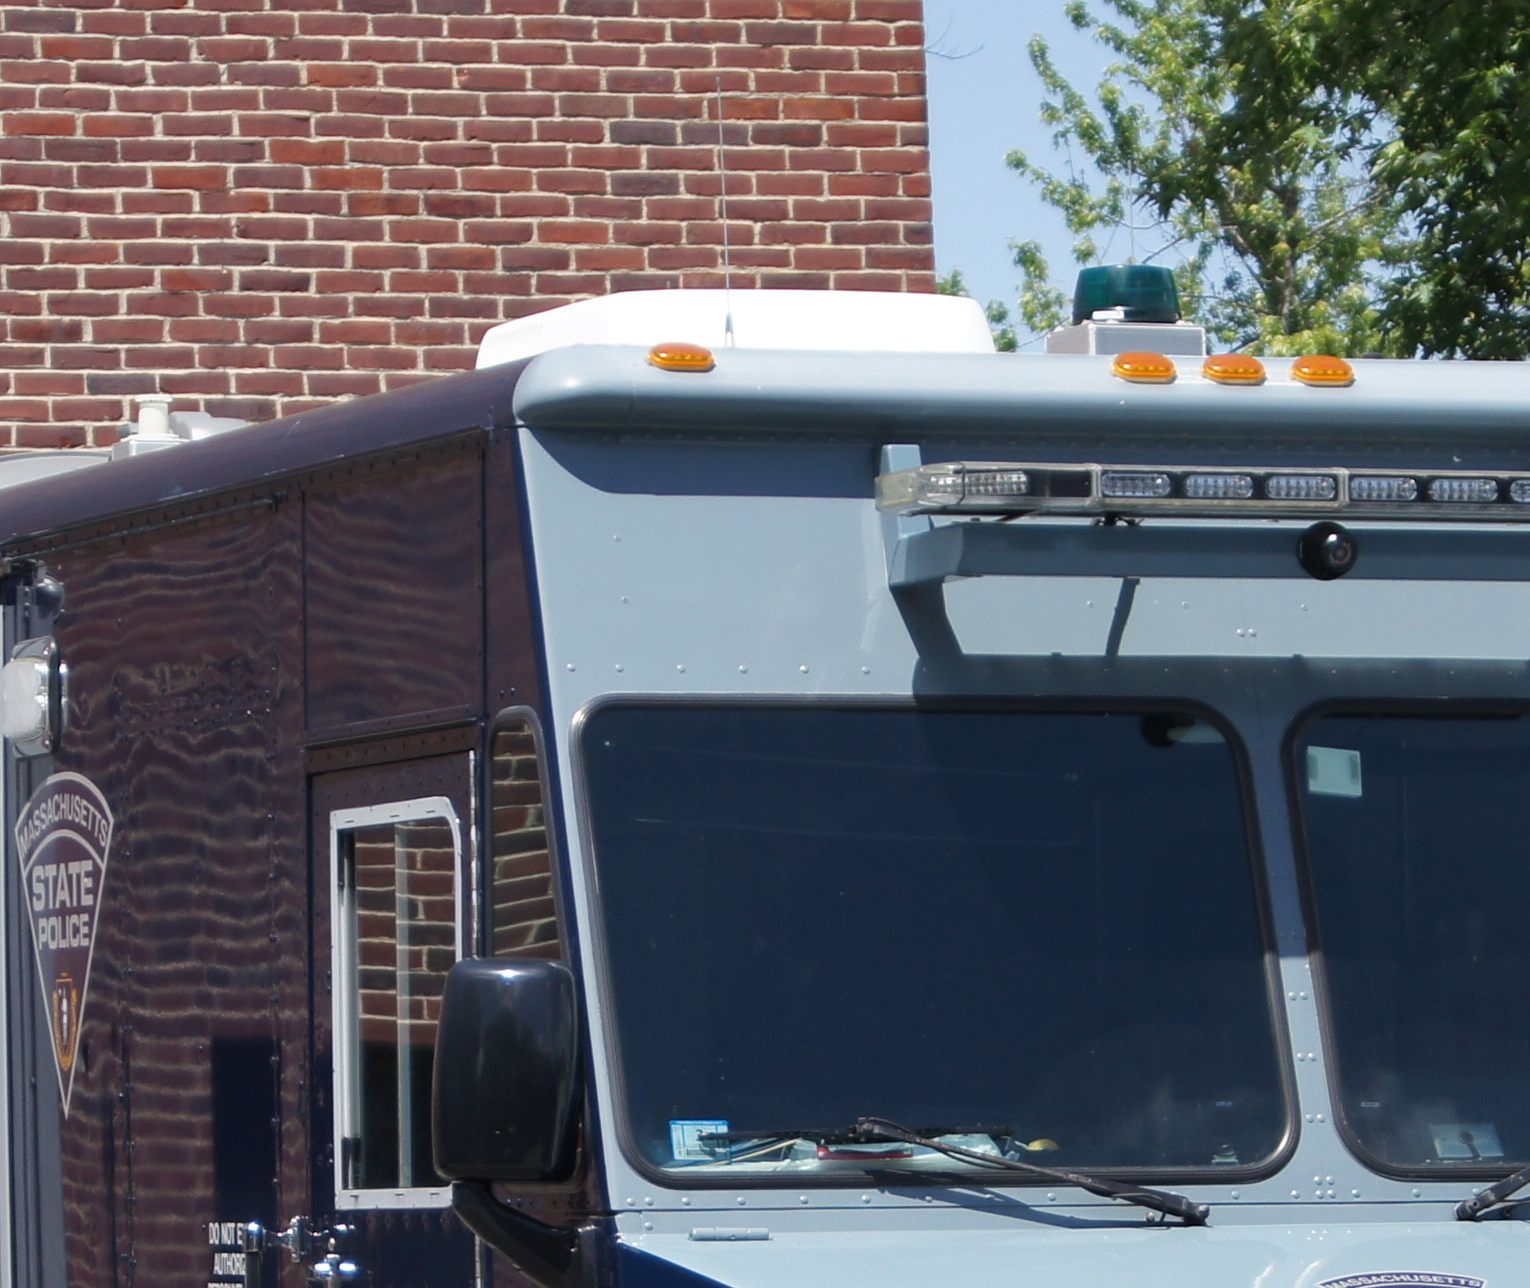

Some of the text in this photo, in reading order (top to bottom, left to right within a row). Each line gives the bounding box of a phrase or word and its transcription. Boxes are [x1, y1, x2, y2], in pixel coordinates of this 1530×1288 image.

[19, 793, 108, 856] MASSACHUSETTS
[32, 859, 94, 912] STATE
[38, 913, 90, 950] POLICE
[209, 1222, 220, 1245] DO
[221, 1222, 236, 1245] NOT
